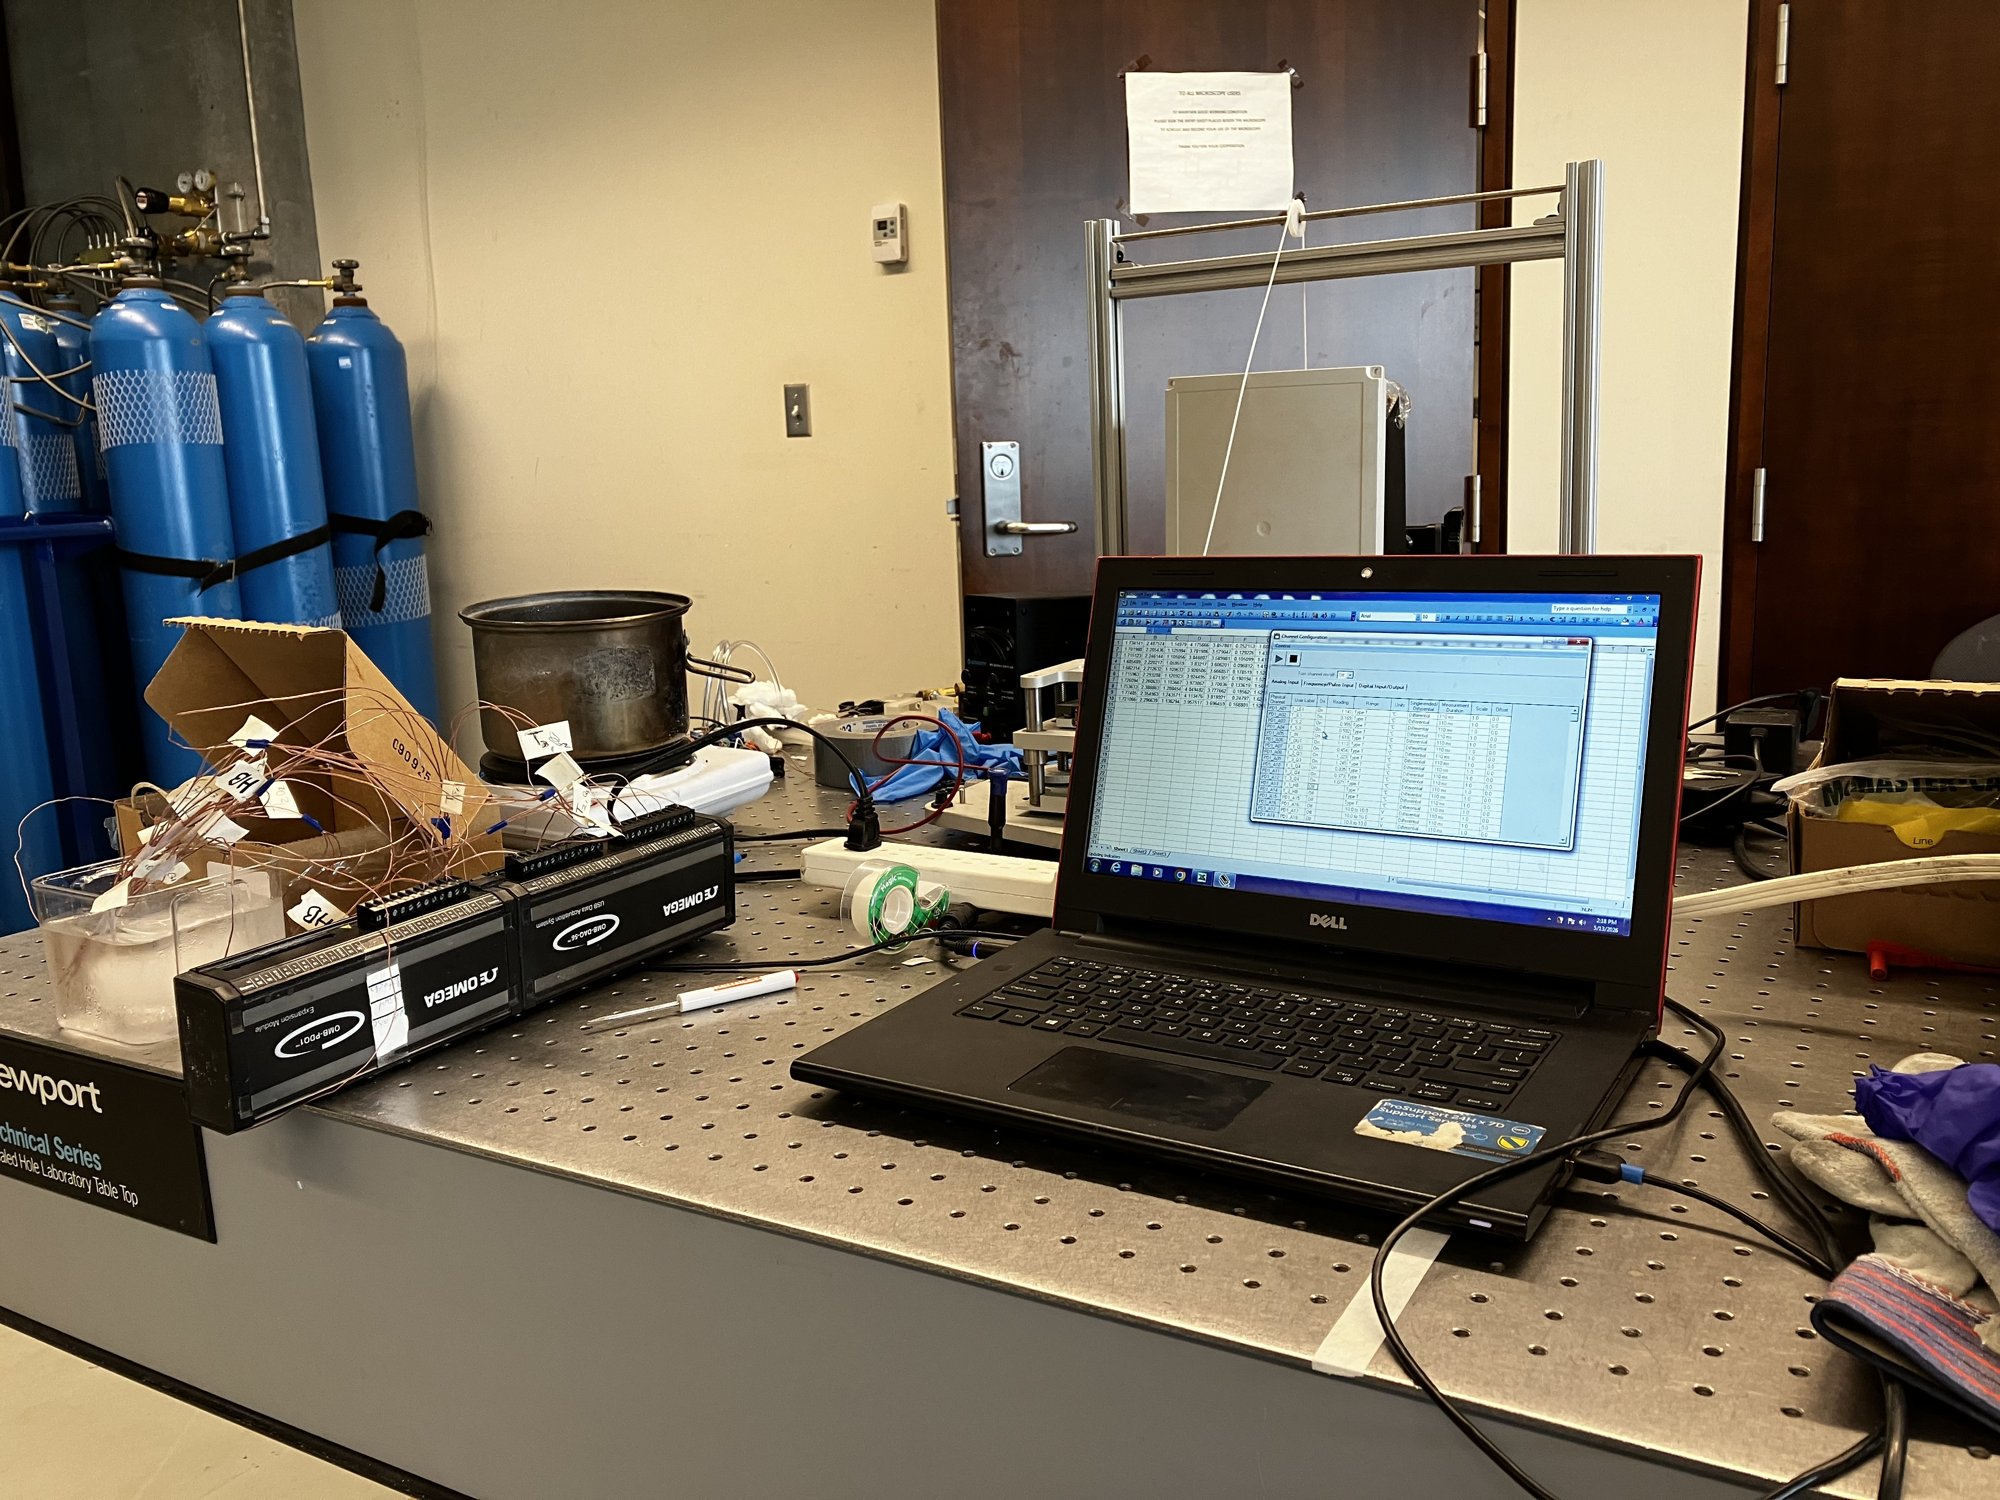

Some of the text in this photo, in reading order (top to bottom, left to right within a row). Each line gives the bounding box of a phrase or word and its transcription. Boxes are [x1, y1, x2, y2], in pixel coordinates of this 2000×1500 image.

[880, 875, 897, 892] Magic
[536, 900, 605, 929] USB Data Acquisition System
[1310, 913, 1348, 930] DELL
[424, 974, 479, 1008] OMEGA
[255, 1006, 314, 1033] Expansion Module
[1378, 1107, 1426, 1121] Support
[1428, 1115, 1477, 1129] Serces
[1383, 1101, 1450, 1119] ProSupport
[1451, 1114, 1477, 1124] 24H
[1489, 1120, 1505, 1129] 7D
[53, 1136, 102, 1171] Series
[18, 1153, 40, 1175] Hole
[40, 1160, 92, 1194] Laboratory
[92, 1176, 119, 1200] Table
[119, 1184, 139, 1207] Top
